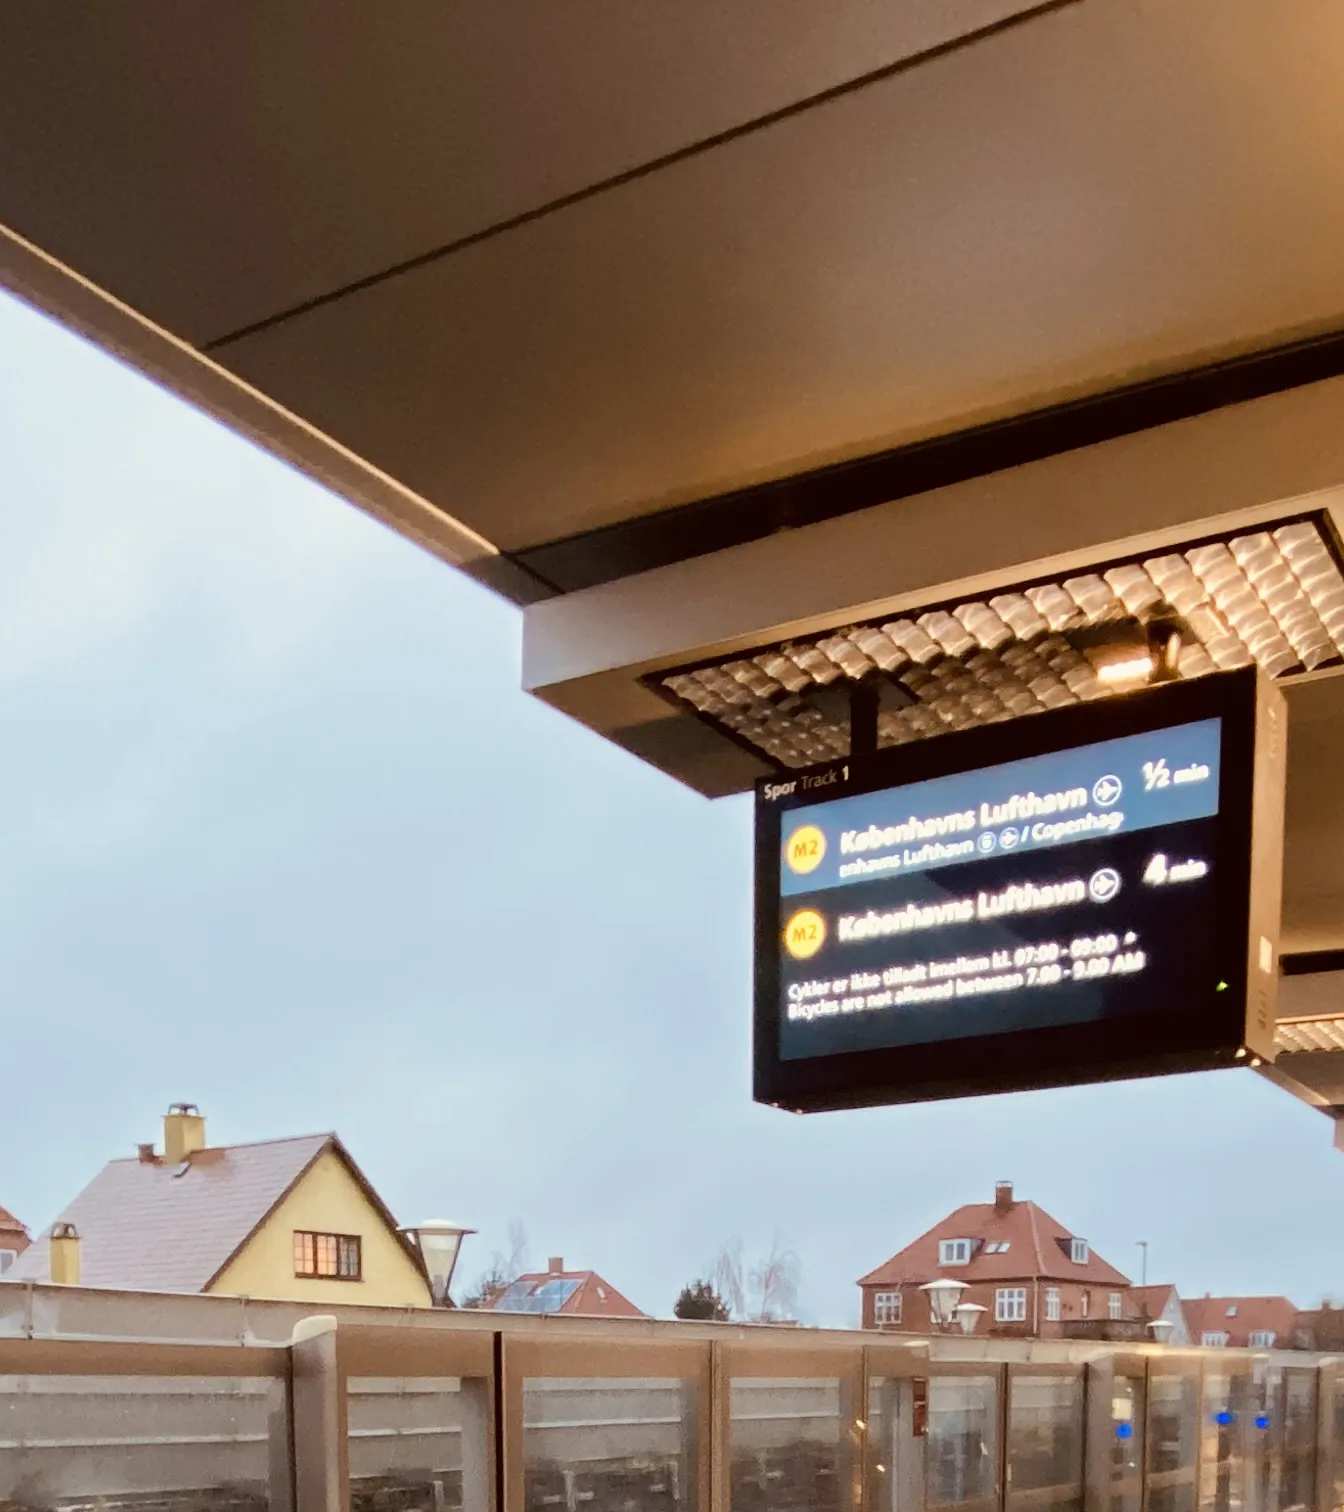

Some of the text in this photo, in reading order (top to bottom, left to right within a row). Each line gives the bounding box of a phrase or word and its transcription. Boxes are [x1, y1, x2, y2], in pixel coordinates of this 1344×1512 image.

[763, 765, 850, 801] Spor Track 1
[840, 809, 975, 854] Københavns
[980, 786, 1087, 827] Lufthavn
[1173, 763, 1210, 785] min
[794, 839, 819, 859] M2
[903, 839, 974, 865] Lufthavn
[839, 853, 1208, 942] Københavns Lufthavn 4 min
[792, 924, 817, 943] M2
[787, 998, 840, 1021] Bicycles
[840, 995, 866, 1013] are
[866, 989, 893, 1010] not
[894, 978, 954, 1003] allowed
[955, 972, 1024, 995] between
[1072, 956, 1110, 981] 9.00
[1110, 950, 1144, 975] AM
[788, 979, 831, 1001] Cykler
[832, 978, 849, 994] er
[850, 971, 881, 992] ikke
[882, 964, 926, 986] tilladt
[992, 950, 1012, 970] kl.
[1013, 942, 1059, 967] 07:00
